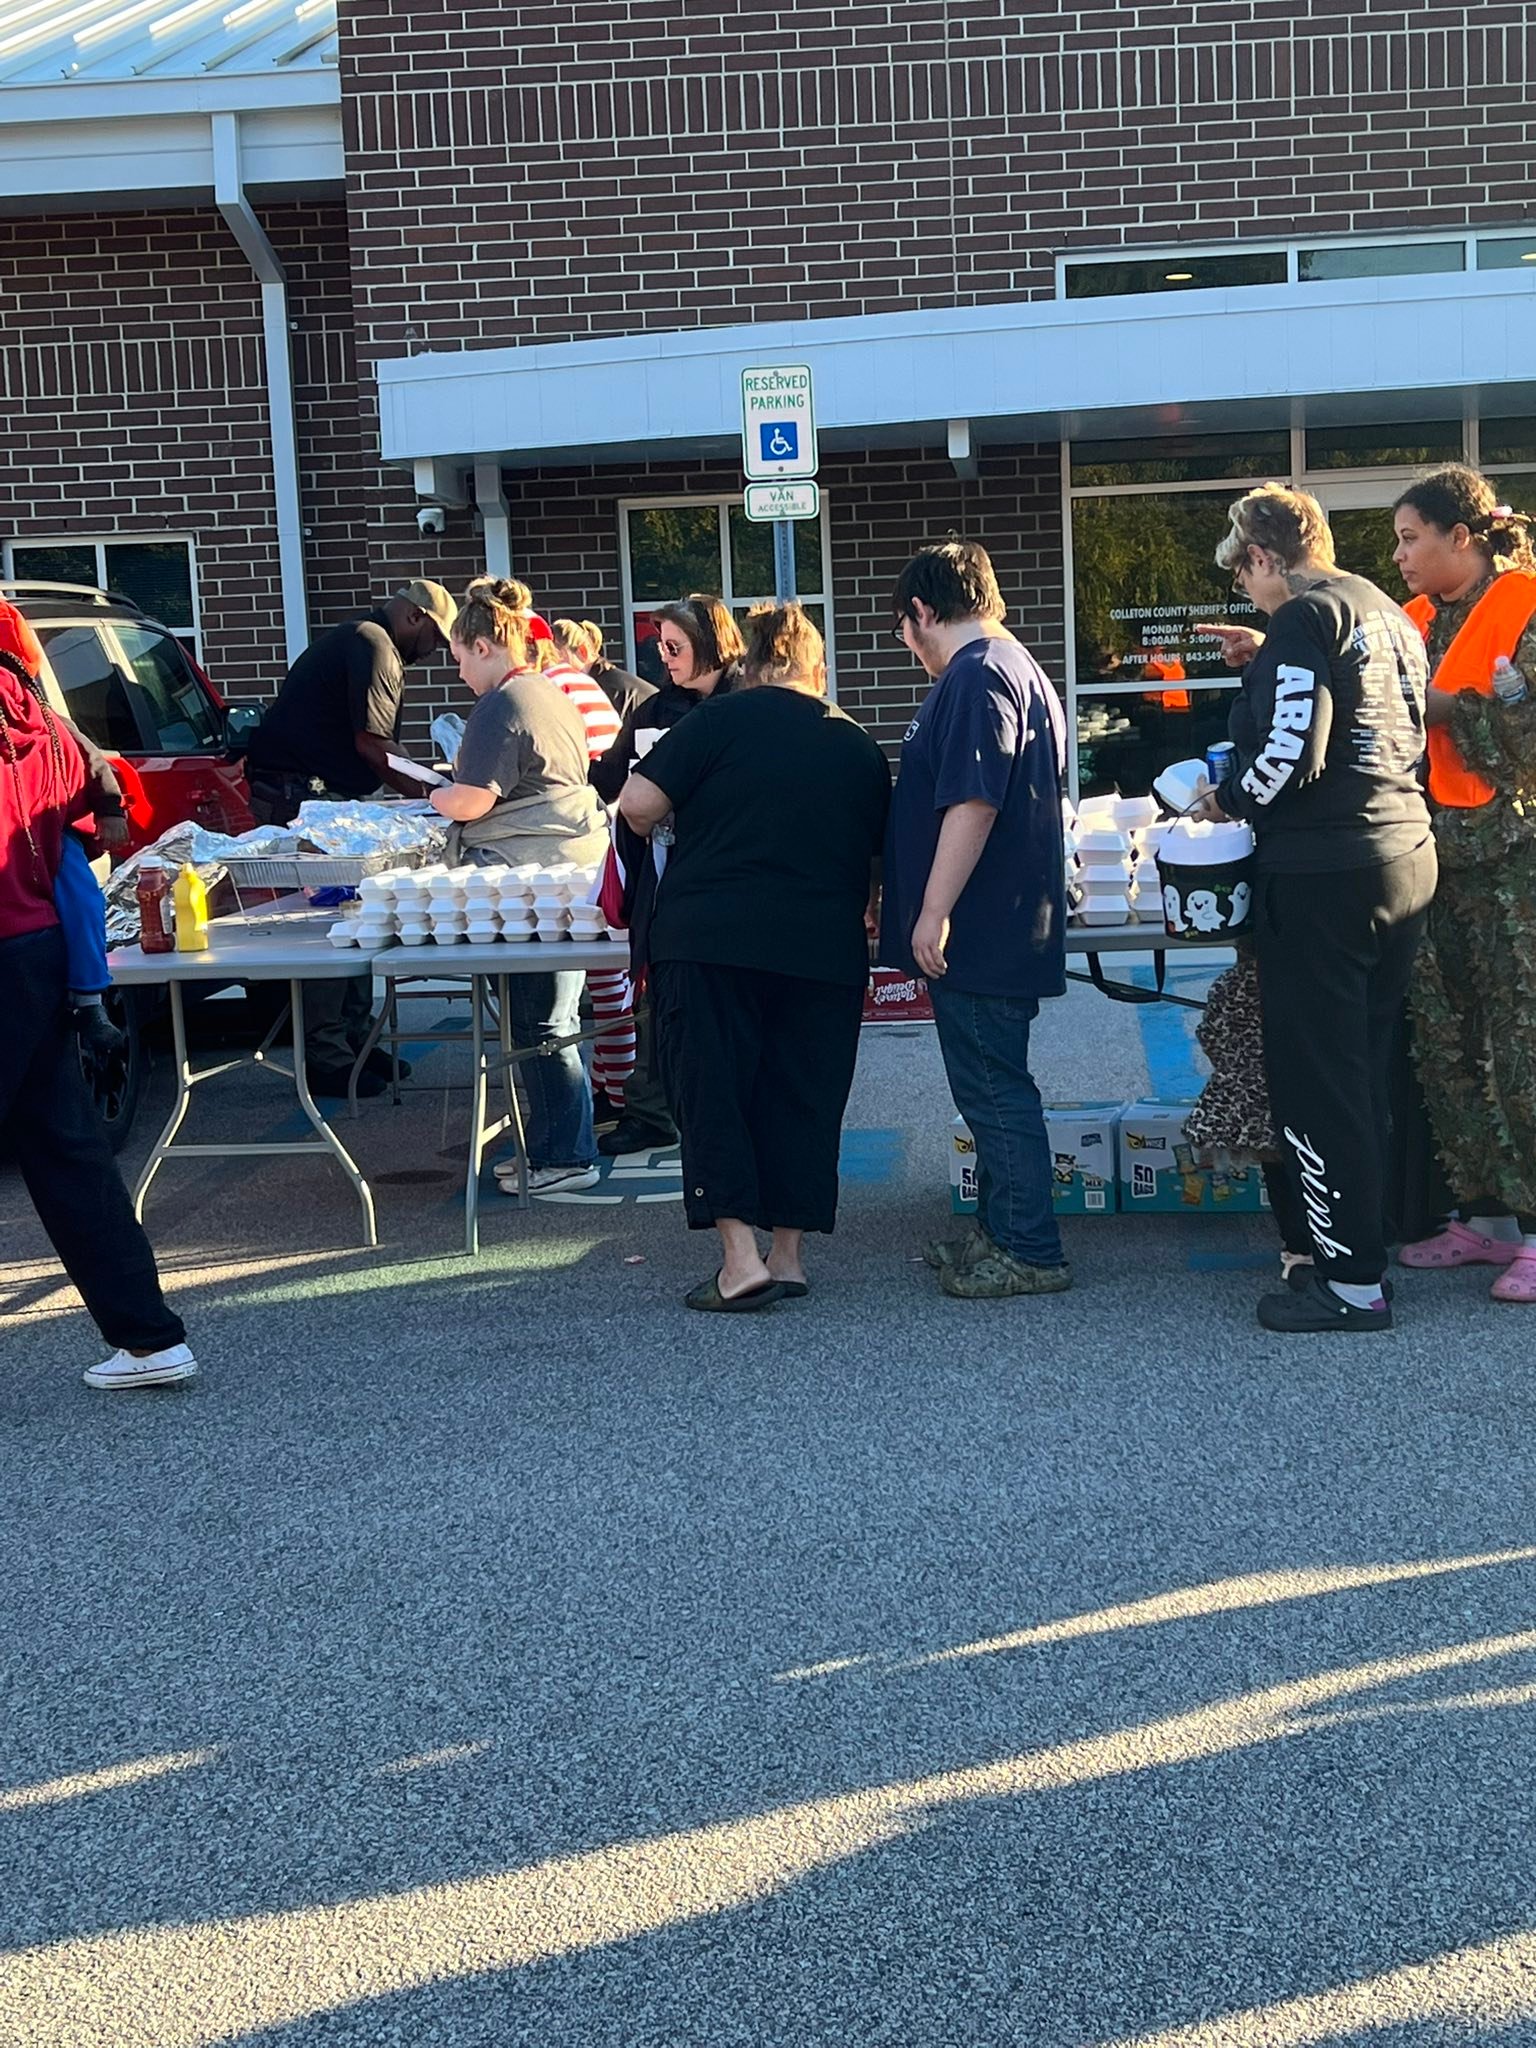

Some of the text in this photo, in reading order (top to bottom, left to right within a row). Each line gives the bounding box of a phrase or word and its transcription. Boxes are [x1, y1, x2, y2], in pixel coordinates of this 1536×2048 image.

[745, 375, 808, 391] RESERVED
[750, 394, 805, 410] PARKING
[769, 491, 794, 501] VAN
[758, 502, 806, 513] ACCESSIBLE
[1110, 608, 1152, 620] COLLETON
[1153, 605, 1187, 618] COUNTY
[1188, 604, 1228, 616] SHERIFF'S
[1142, 624, 1184, 635] MONDAY
[1142, 635, 1179, 646] 8:00AM
[1122, 654, 1148, 665] AFTER
[1186, 651, 1226, 662] 843-549-
[1240, 663, 1315, 806] ABATE
[1134, 1164, 1154, 1183] 50
[1283, 1126, 1352, 1261] pink
